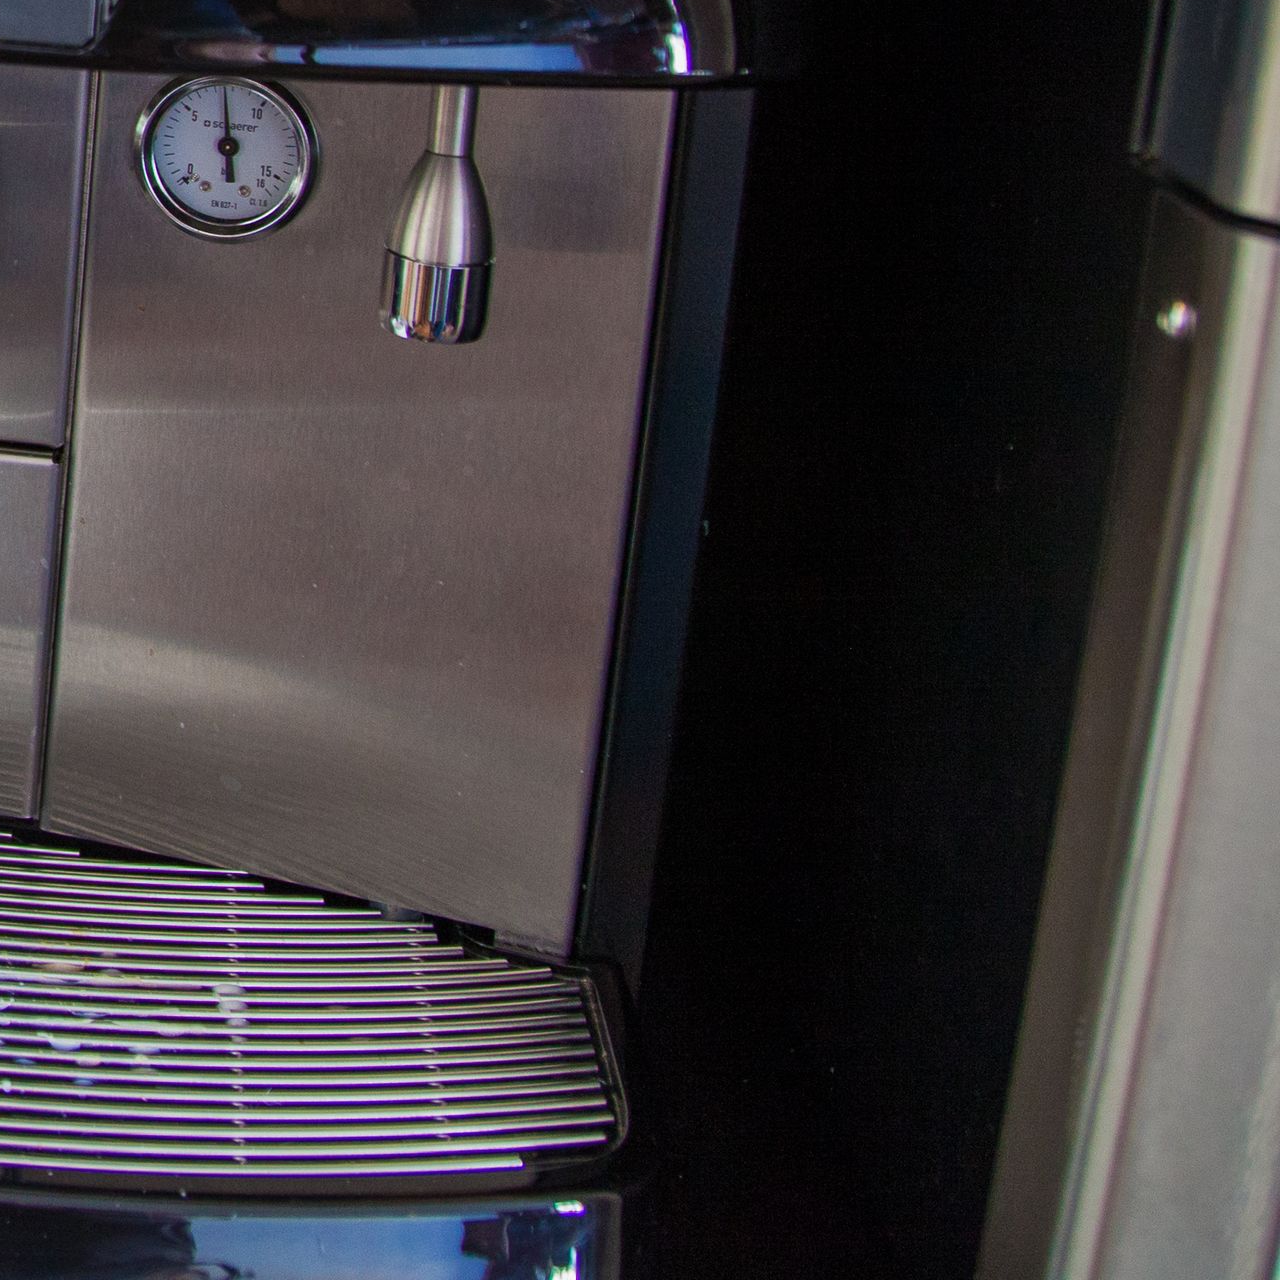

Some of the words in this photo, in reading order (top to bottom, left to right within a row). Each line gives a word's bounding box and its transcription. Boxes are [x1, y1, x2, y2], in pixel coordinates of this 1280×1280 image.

[192, 111, 198, 122] 5
[251, 108, 264, 120] 10
[212, 121, 259, 133] scaerer
[187, 163, 194, 174] 0
[260, 166, 272, 177] 15
[256, 178, 266, 188] 16
